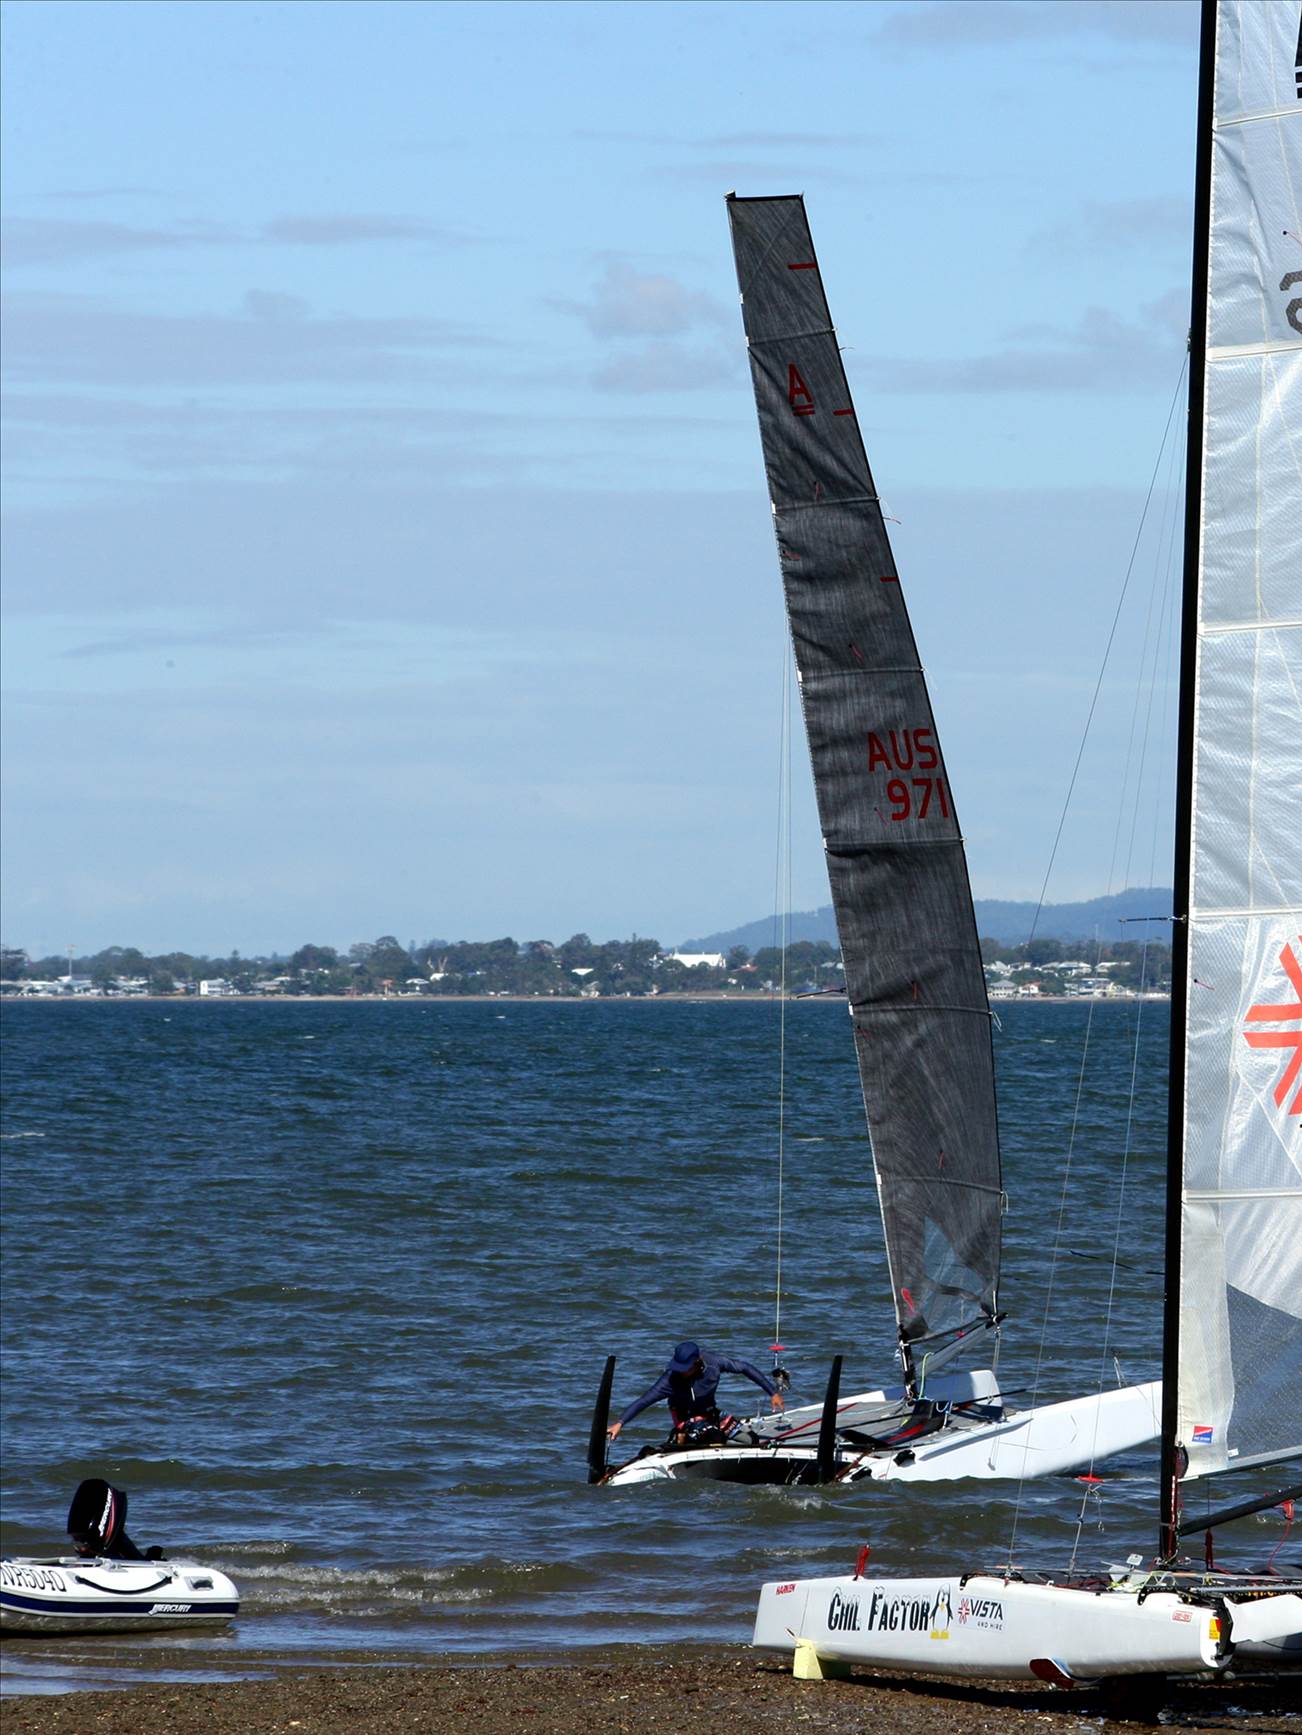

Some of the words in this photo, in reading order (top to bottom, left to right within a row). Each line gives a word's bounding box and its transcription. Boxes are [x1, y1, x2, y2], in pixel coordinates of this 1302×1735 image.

[787, 362, 813, 405] A
[867, 728, 938, 772] AUS
[886, 778, 949, 821] 971
[148, 1604, 192, 1615] MERCURY
[867, 1591, 930, 1631] FACTOR
[970, 1599, 1003, 1620] VISTA
